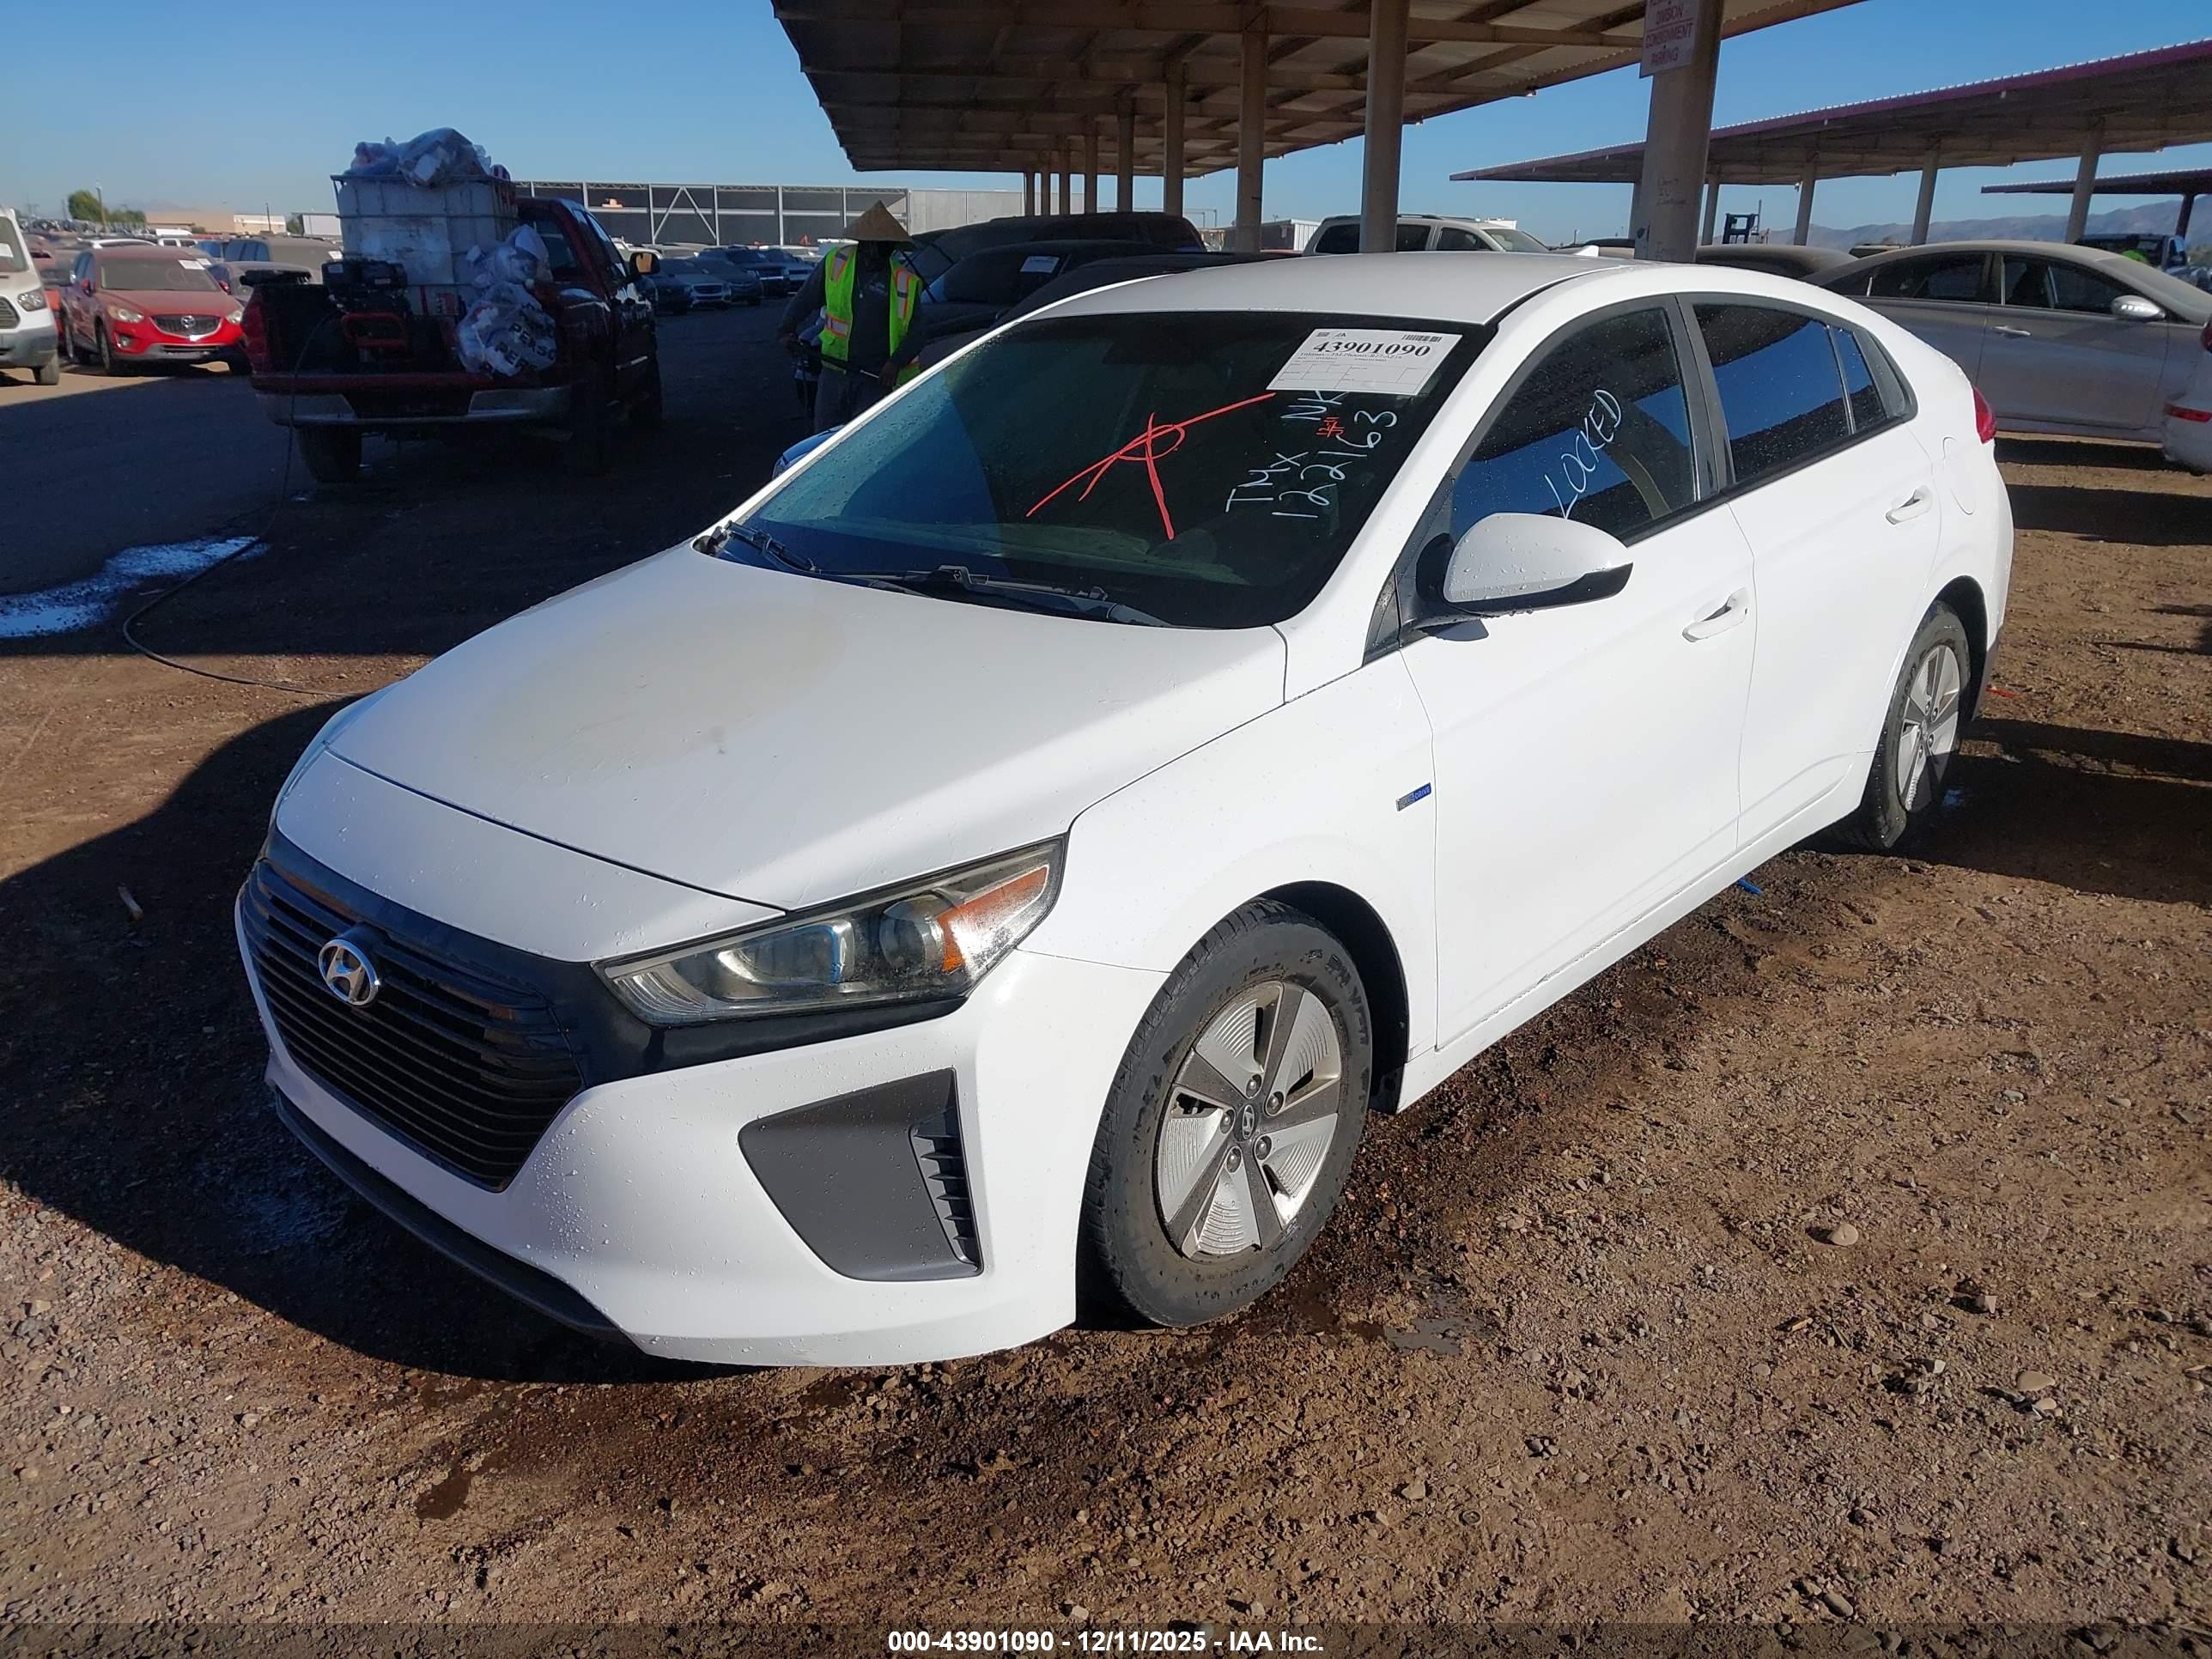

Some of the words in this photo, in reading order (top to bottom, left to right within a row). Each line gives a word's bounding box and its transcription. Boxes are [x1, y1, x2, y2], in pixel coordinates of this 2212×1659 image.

[1313, 341, 1431, 357] 43901090
[1225, 452, 1309, 513] TMX
[1272, 410, 1397, 518] 122163
[1545, 389, 1621, 520] LOCKED
